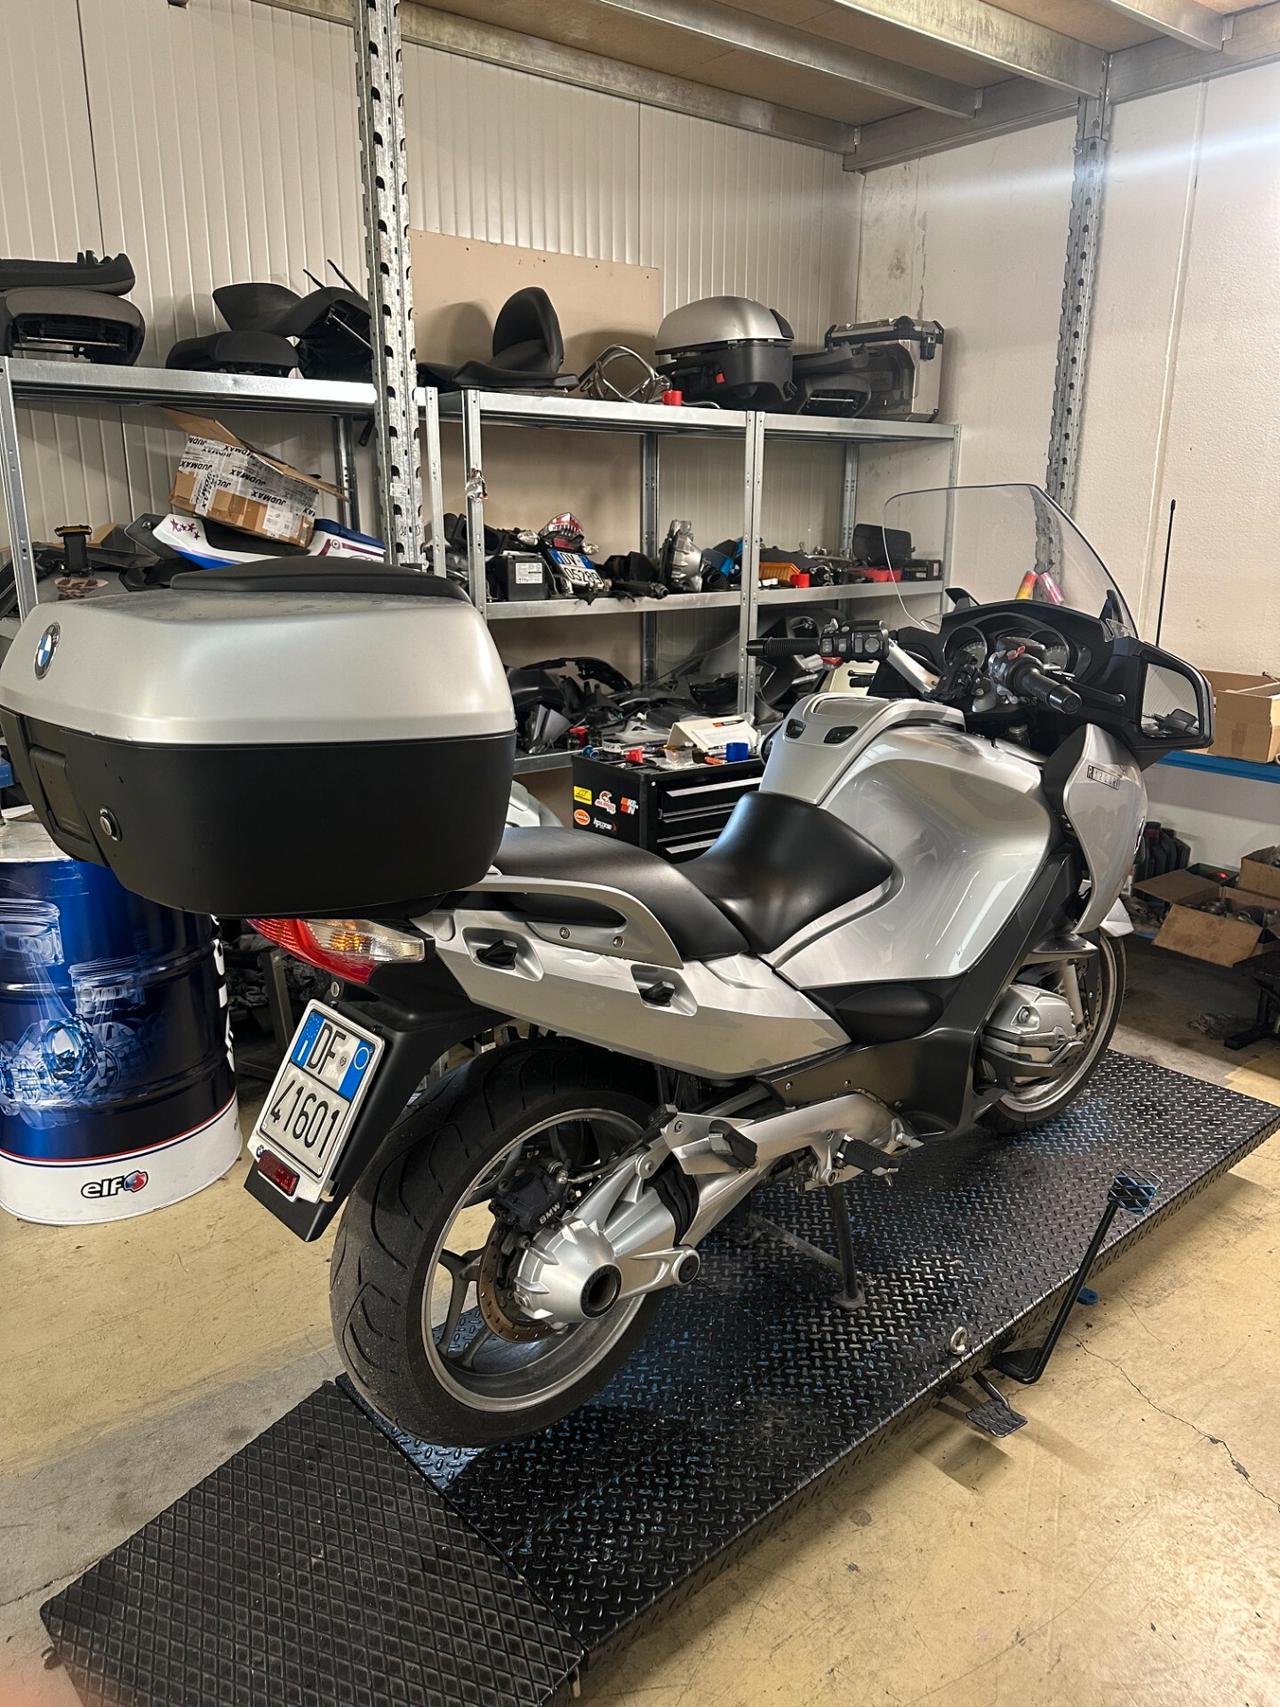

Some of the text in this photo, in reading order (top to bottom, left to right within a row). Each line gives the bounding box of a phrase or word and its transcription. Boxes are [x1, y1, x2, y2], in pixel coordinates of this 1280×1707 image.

[179, 460, 213, 471] JUDMAX
[229, 468, 266, 487] JUDMAX
[251, 489, 287, 506] JUDMAX
[306, 1025, 346, 1075] DF
[270, 1080, 341, 1158] 41601
[81, 1176, 125, 1199] elf
[539, 1202, 561, 1224] BMW
